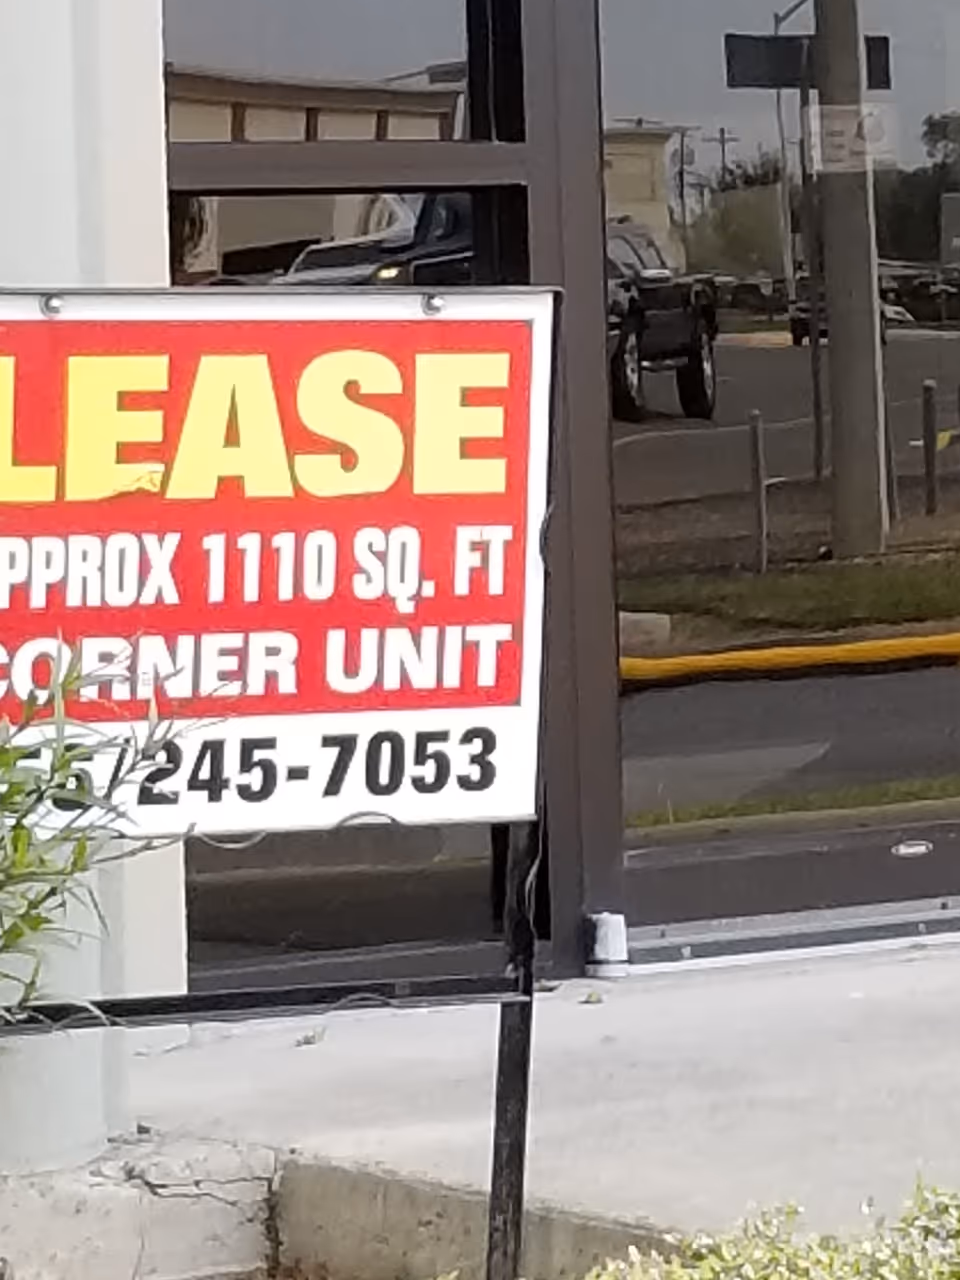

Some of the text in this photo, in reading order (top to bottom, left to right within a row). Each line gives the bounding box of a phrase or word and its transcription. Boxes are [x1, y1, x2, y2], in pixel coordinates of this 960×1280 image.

[0, 349, 511, 502] LEASE
[202, 529, 337, 604] 1110
[352, 525, 435, 613] SQ.
[453, 525, 513, 597] FT
[0, 624, 512, 703] ORNER UNIT
